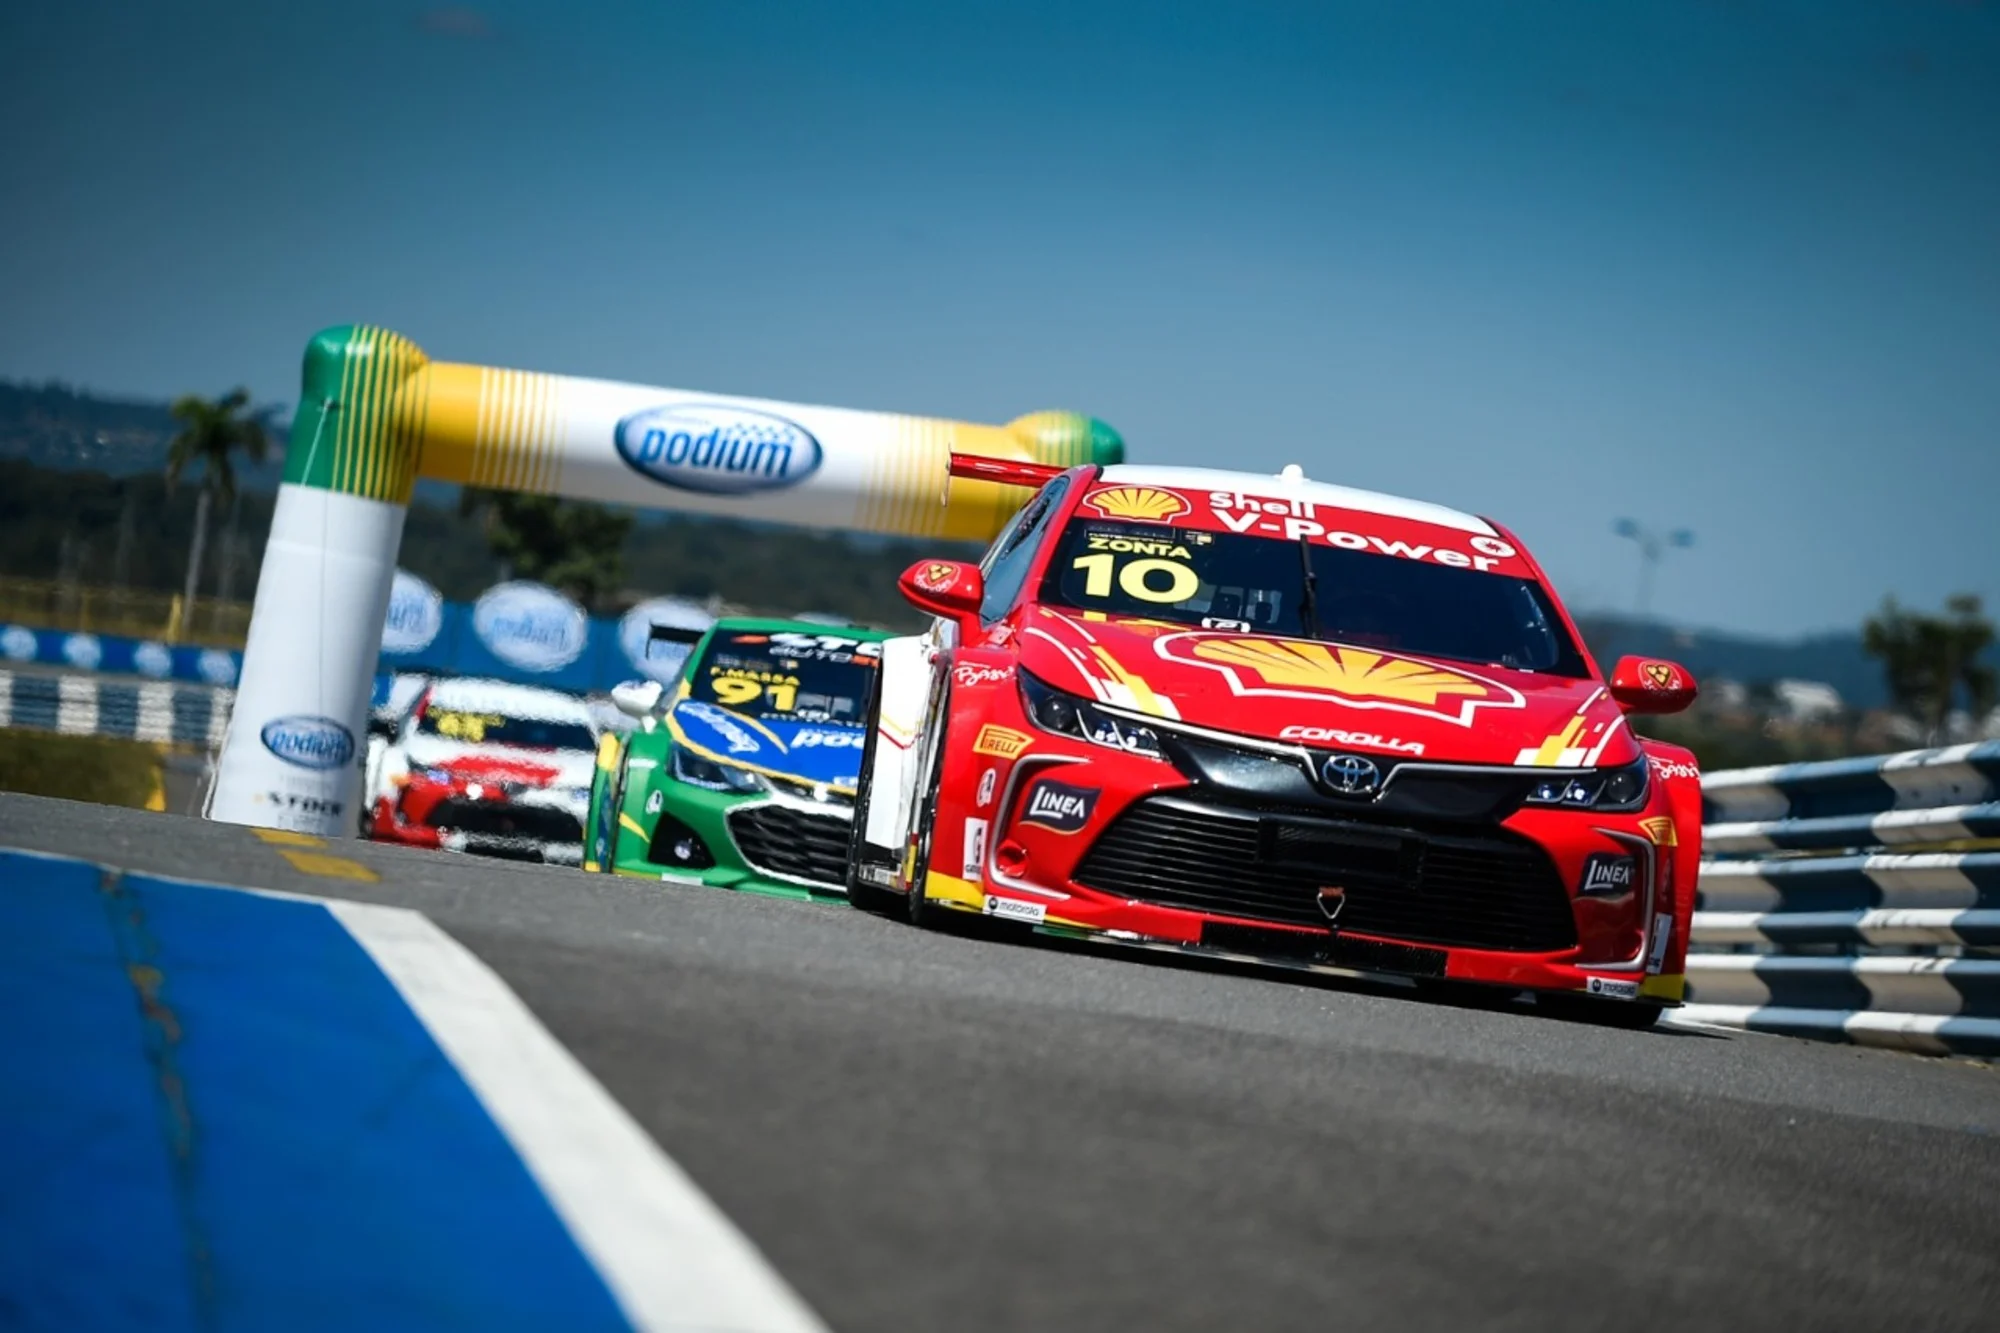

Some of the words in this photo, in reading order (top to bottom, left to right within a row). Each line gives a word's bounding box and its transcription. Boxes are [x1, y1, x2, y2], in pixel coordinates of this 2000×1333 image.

[637, 427, 793, 479] podium
[1088, 537, 1192, 560] ZONTA
[1211, 508, 1500, 572] V-Power
[1073, 553, 1200, 604] 10
[711, 676, 797, 712] 91
[1279, 725, 1426, 757] COROLLA
[1029, 785, 1085, 819] LINEA
[1584, 859, 1630, 890] LINEA
